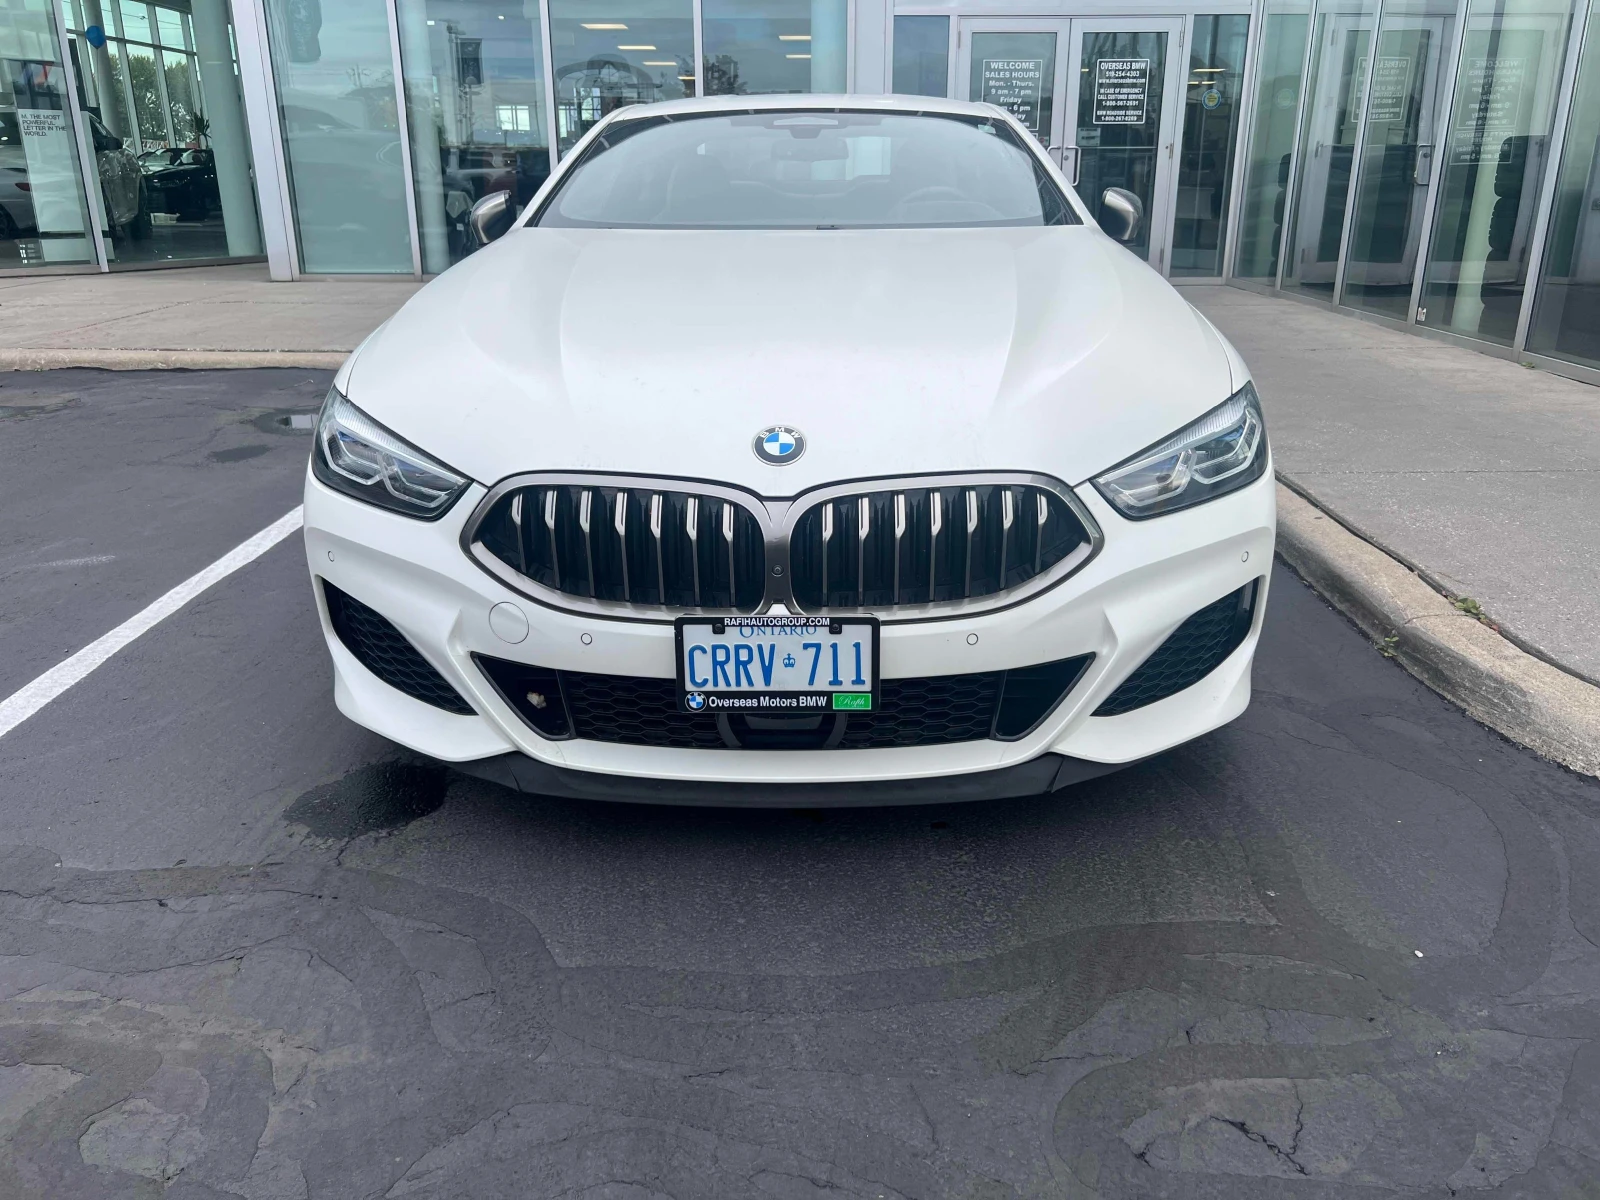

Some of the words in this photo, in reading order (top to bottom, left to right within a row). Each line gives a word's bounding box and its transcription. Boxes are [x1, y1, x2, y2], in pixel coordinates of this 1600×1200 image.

[760, 427, 801, 438] BMW
[724, 618, 830, 626] RAFIHAUTOGROUP.COM
[739, 626, 817, 638] ONTARIO
[688, 643, 776, 688] CRRV
[802, 641, 866, 686] 711
[709, 696, 758, 707] Overseas
[760, 696, 797, 707] Motors
[800, 696, 827, 706] BMW
